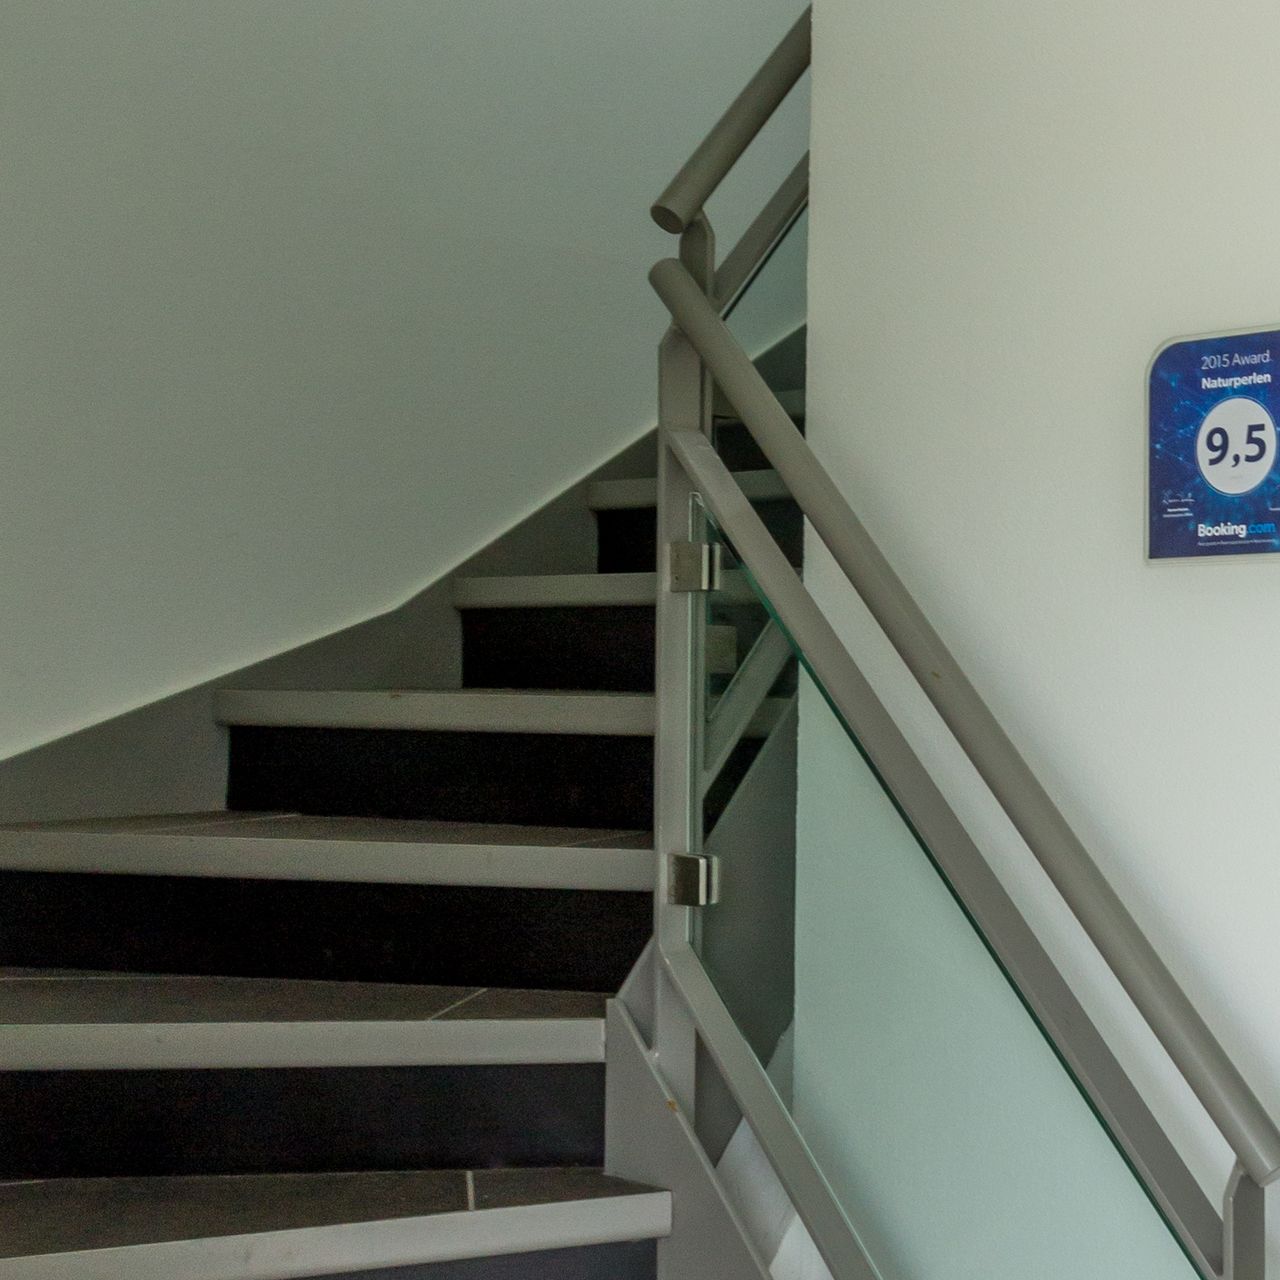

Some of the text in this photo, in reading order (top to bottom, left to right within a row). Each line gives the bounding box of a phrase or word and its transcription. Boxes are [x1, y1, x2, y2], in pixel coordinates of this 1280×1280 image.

[1201, 349, 1271, 370] 2015 Award
[1201, 372, 1271, 390] Naturperlen
[1205, 423, 1267, 468] 9,5
[1197, 521, 1276, 538] Booking.com
